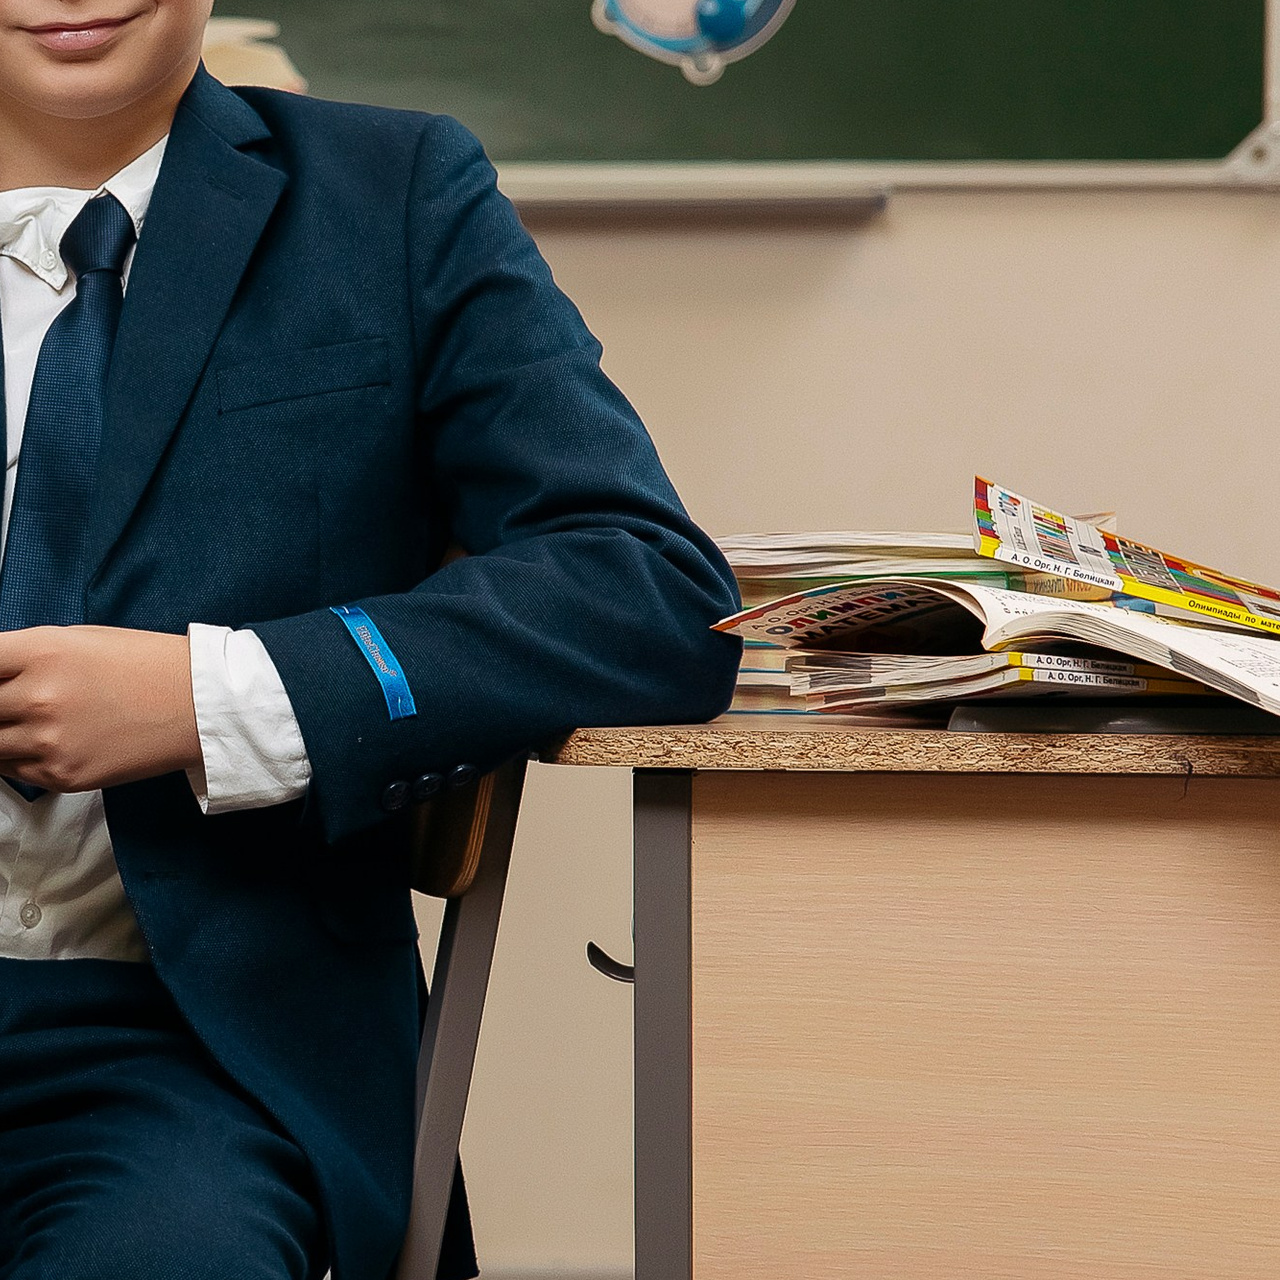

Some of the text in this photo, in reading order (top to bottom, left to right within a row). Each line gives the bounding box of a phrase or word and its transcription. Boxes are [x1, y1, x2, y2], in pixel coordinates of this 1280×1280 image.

[1073, 569, 1115, 587] Белицкая
[1188, 600, 1241, 619] Олимпиады
[1245, 616, 1256, 624] по
